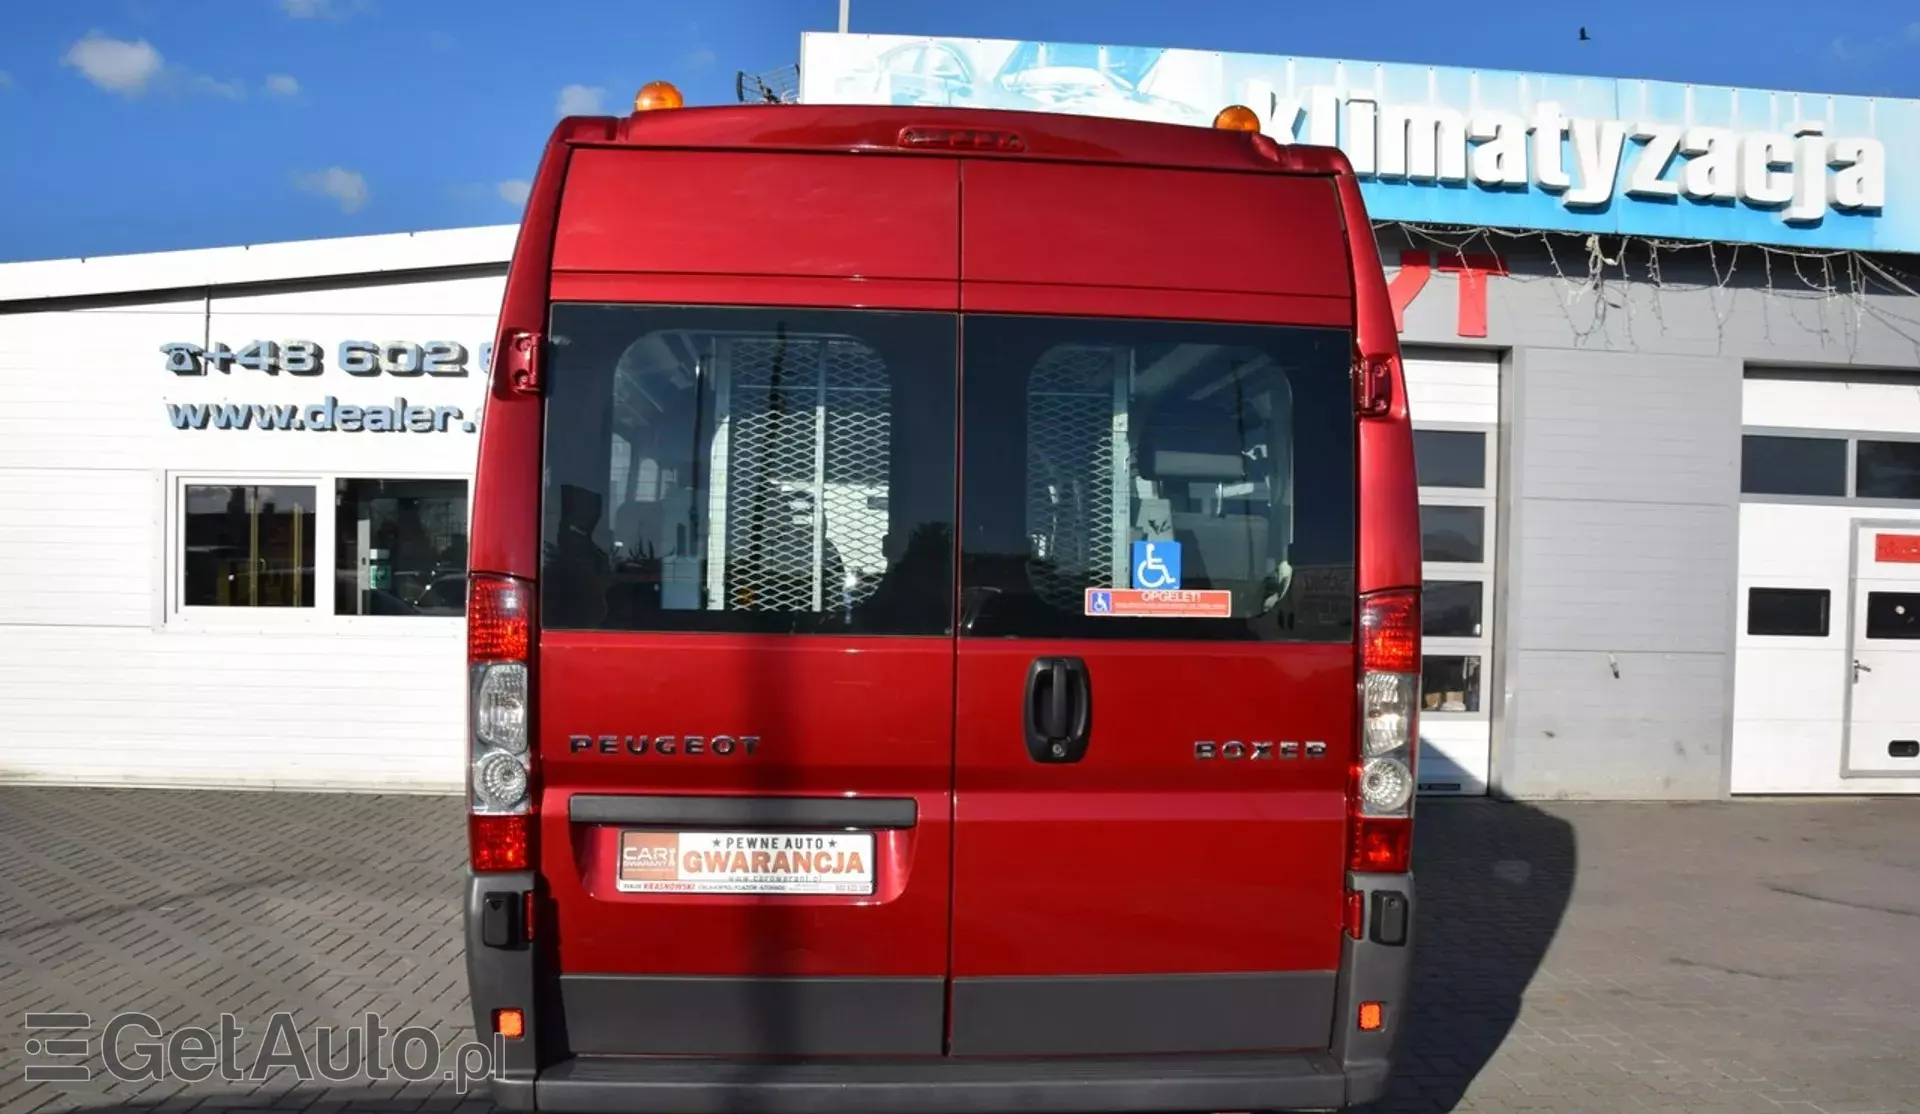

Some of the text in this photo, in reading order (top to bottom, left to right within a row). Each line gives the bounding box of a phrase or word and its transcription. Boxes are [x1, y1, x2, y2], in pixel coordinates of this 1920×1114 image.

[1244, 79, 1885, 228] klimatyzacja
[205, 339, 324, 376] +48
[338, 340, 469, 377] 602
[568, 735, 761, 756] PEUGEOT
[1194, 739, 1327, 760] BOXER
[725, 837, 825, 850] PEWNE AUTO
[682, 851, 865, 874] GWARANCJA
